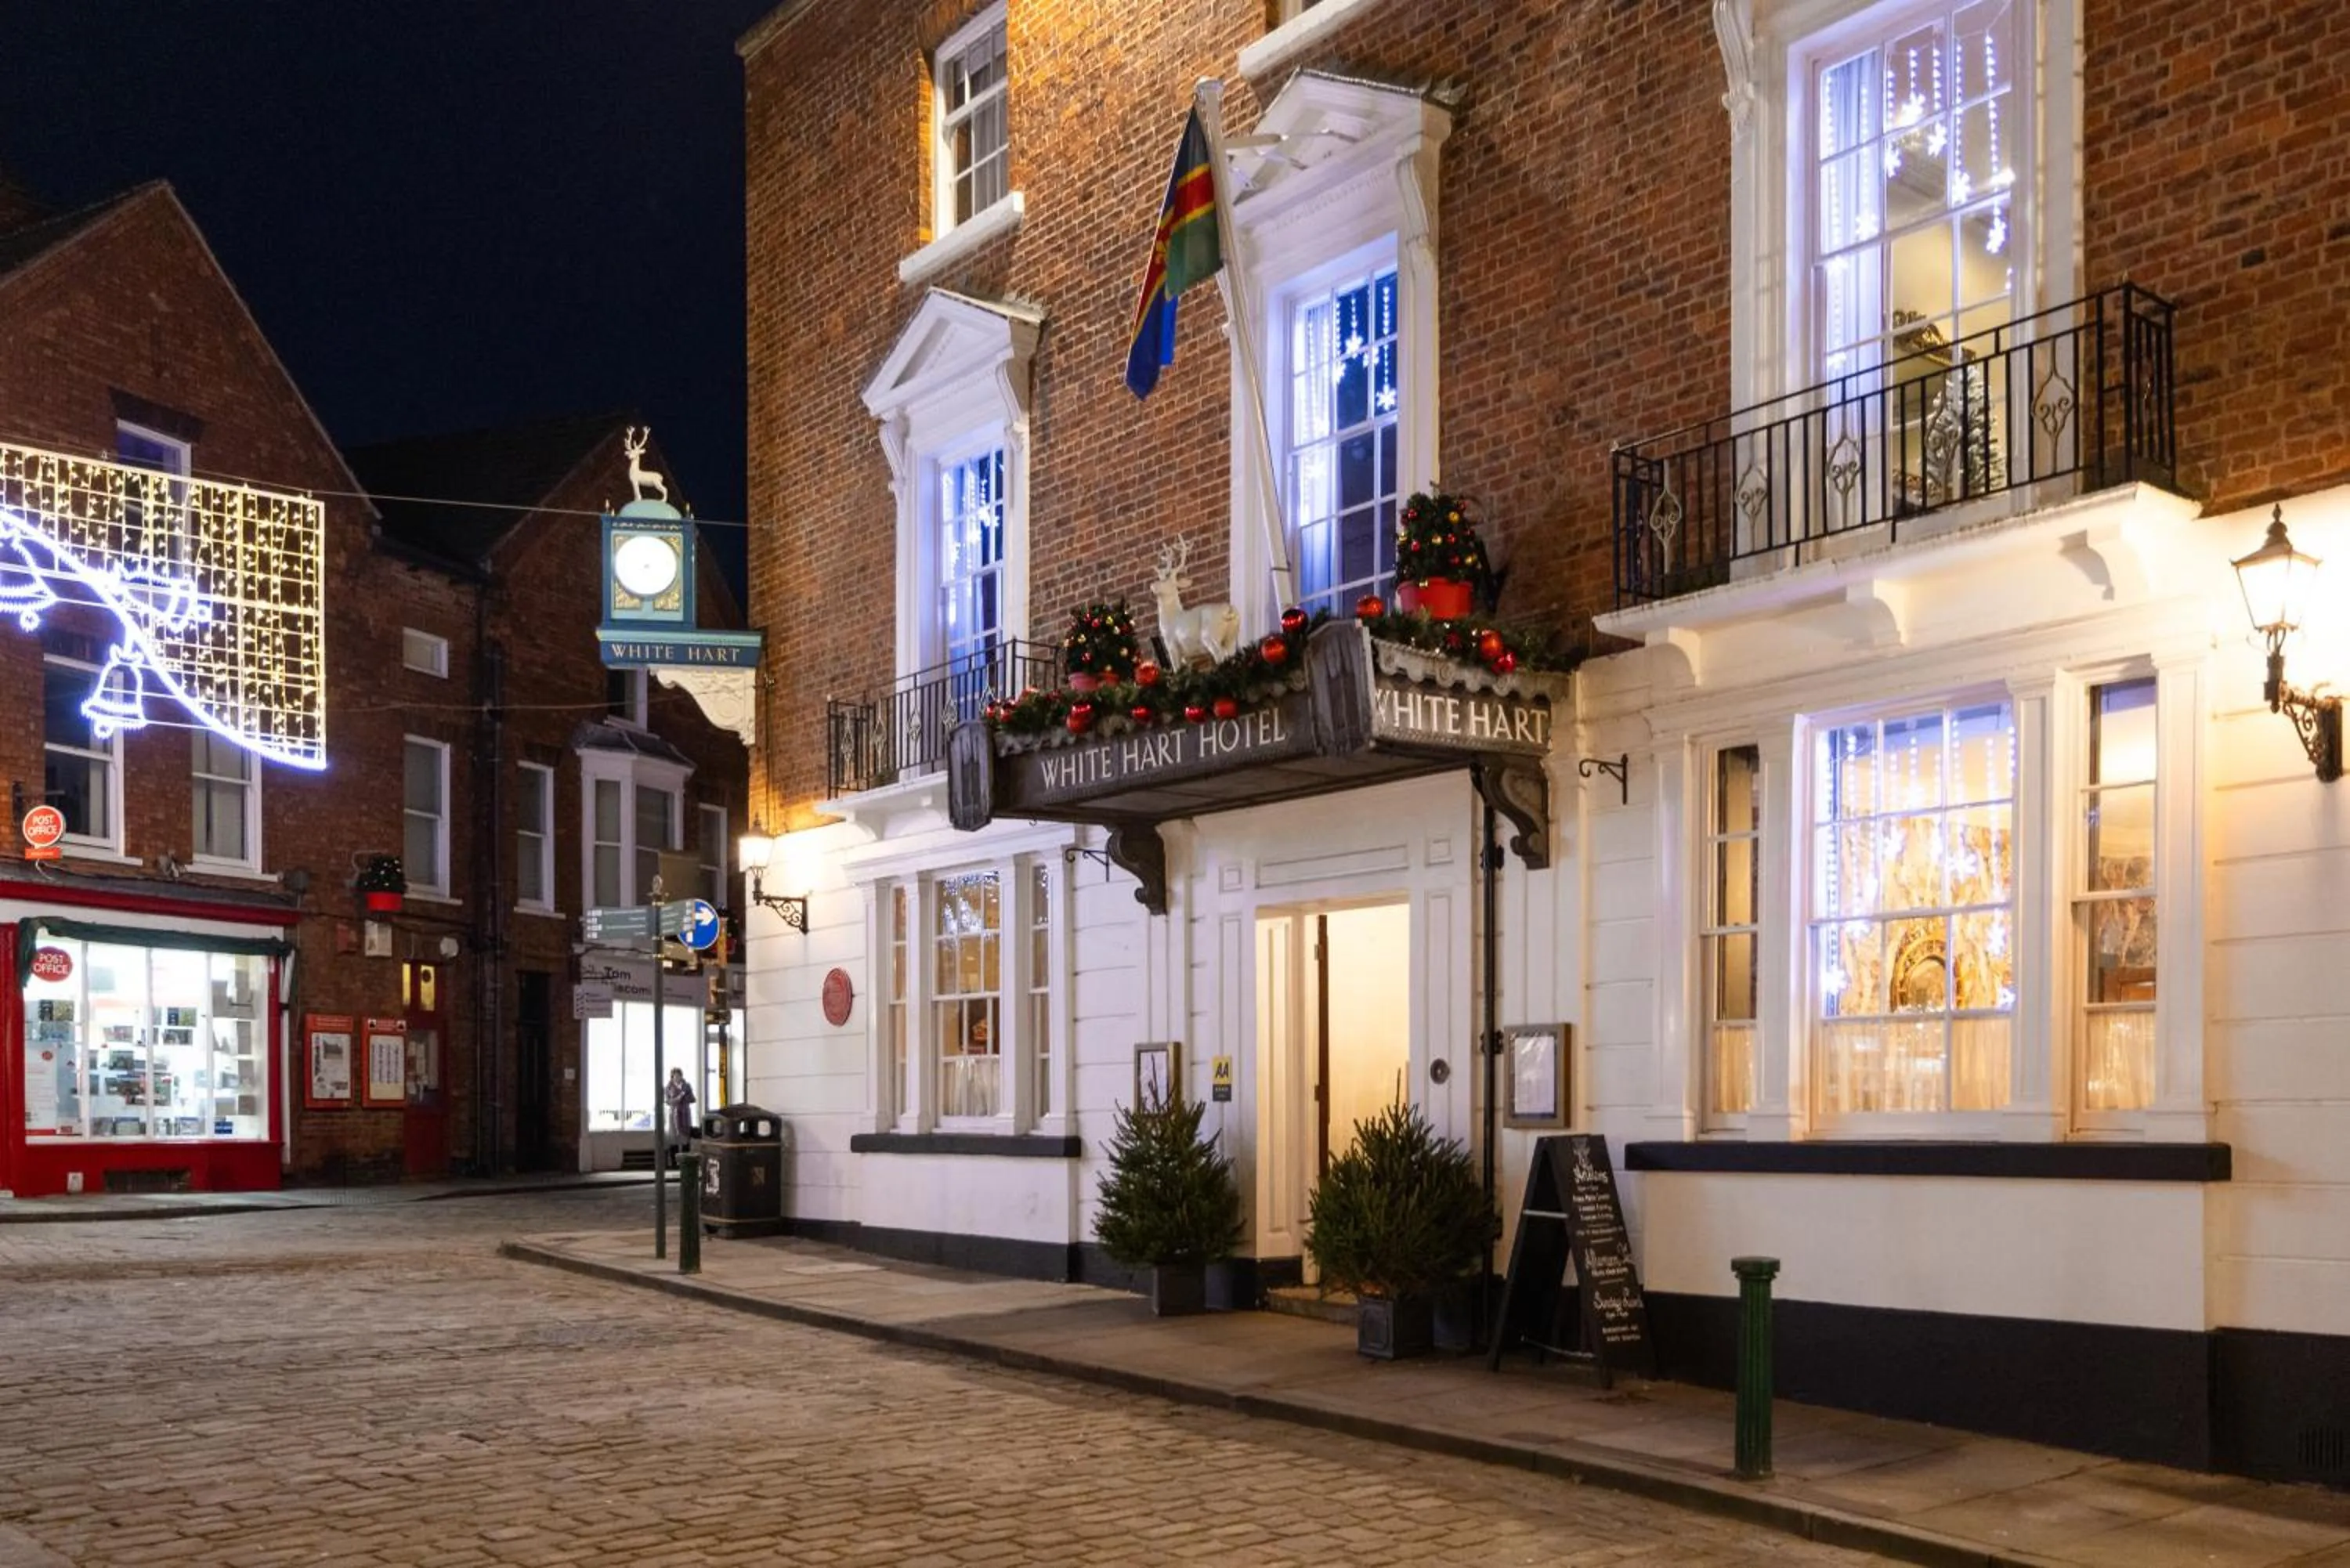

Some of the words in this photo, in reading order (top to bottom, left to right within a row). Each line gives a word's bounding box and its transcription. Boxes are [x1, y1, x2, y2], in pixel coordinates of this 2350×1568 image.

[611, 643, 674, 660] WHITE
[689, 647, 740, 662] HART
[1375, 689, 1461, 734] WHITE
[1468, 700, 1549, 744] HART
[1041, 746, 1112, 789] WHITE
[1123, 728, 1187, 774] HART
[1198, 707, 1286, 757] HOTEL
[33, 815, 55, 826] POST
[28, 825, 58, 836] OFFICE
[40, 953, 63, 964] POST
[34, 963, 68, 974] OFFICE
[1215, 1061, 1229, 1078] AA
